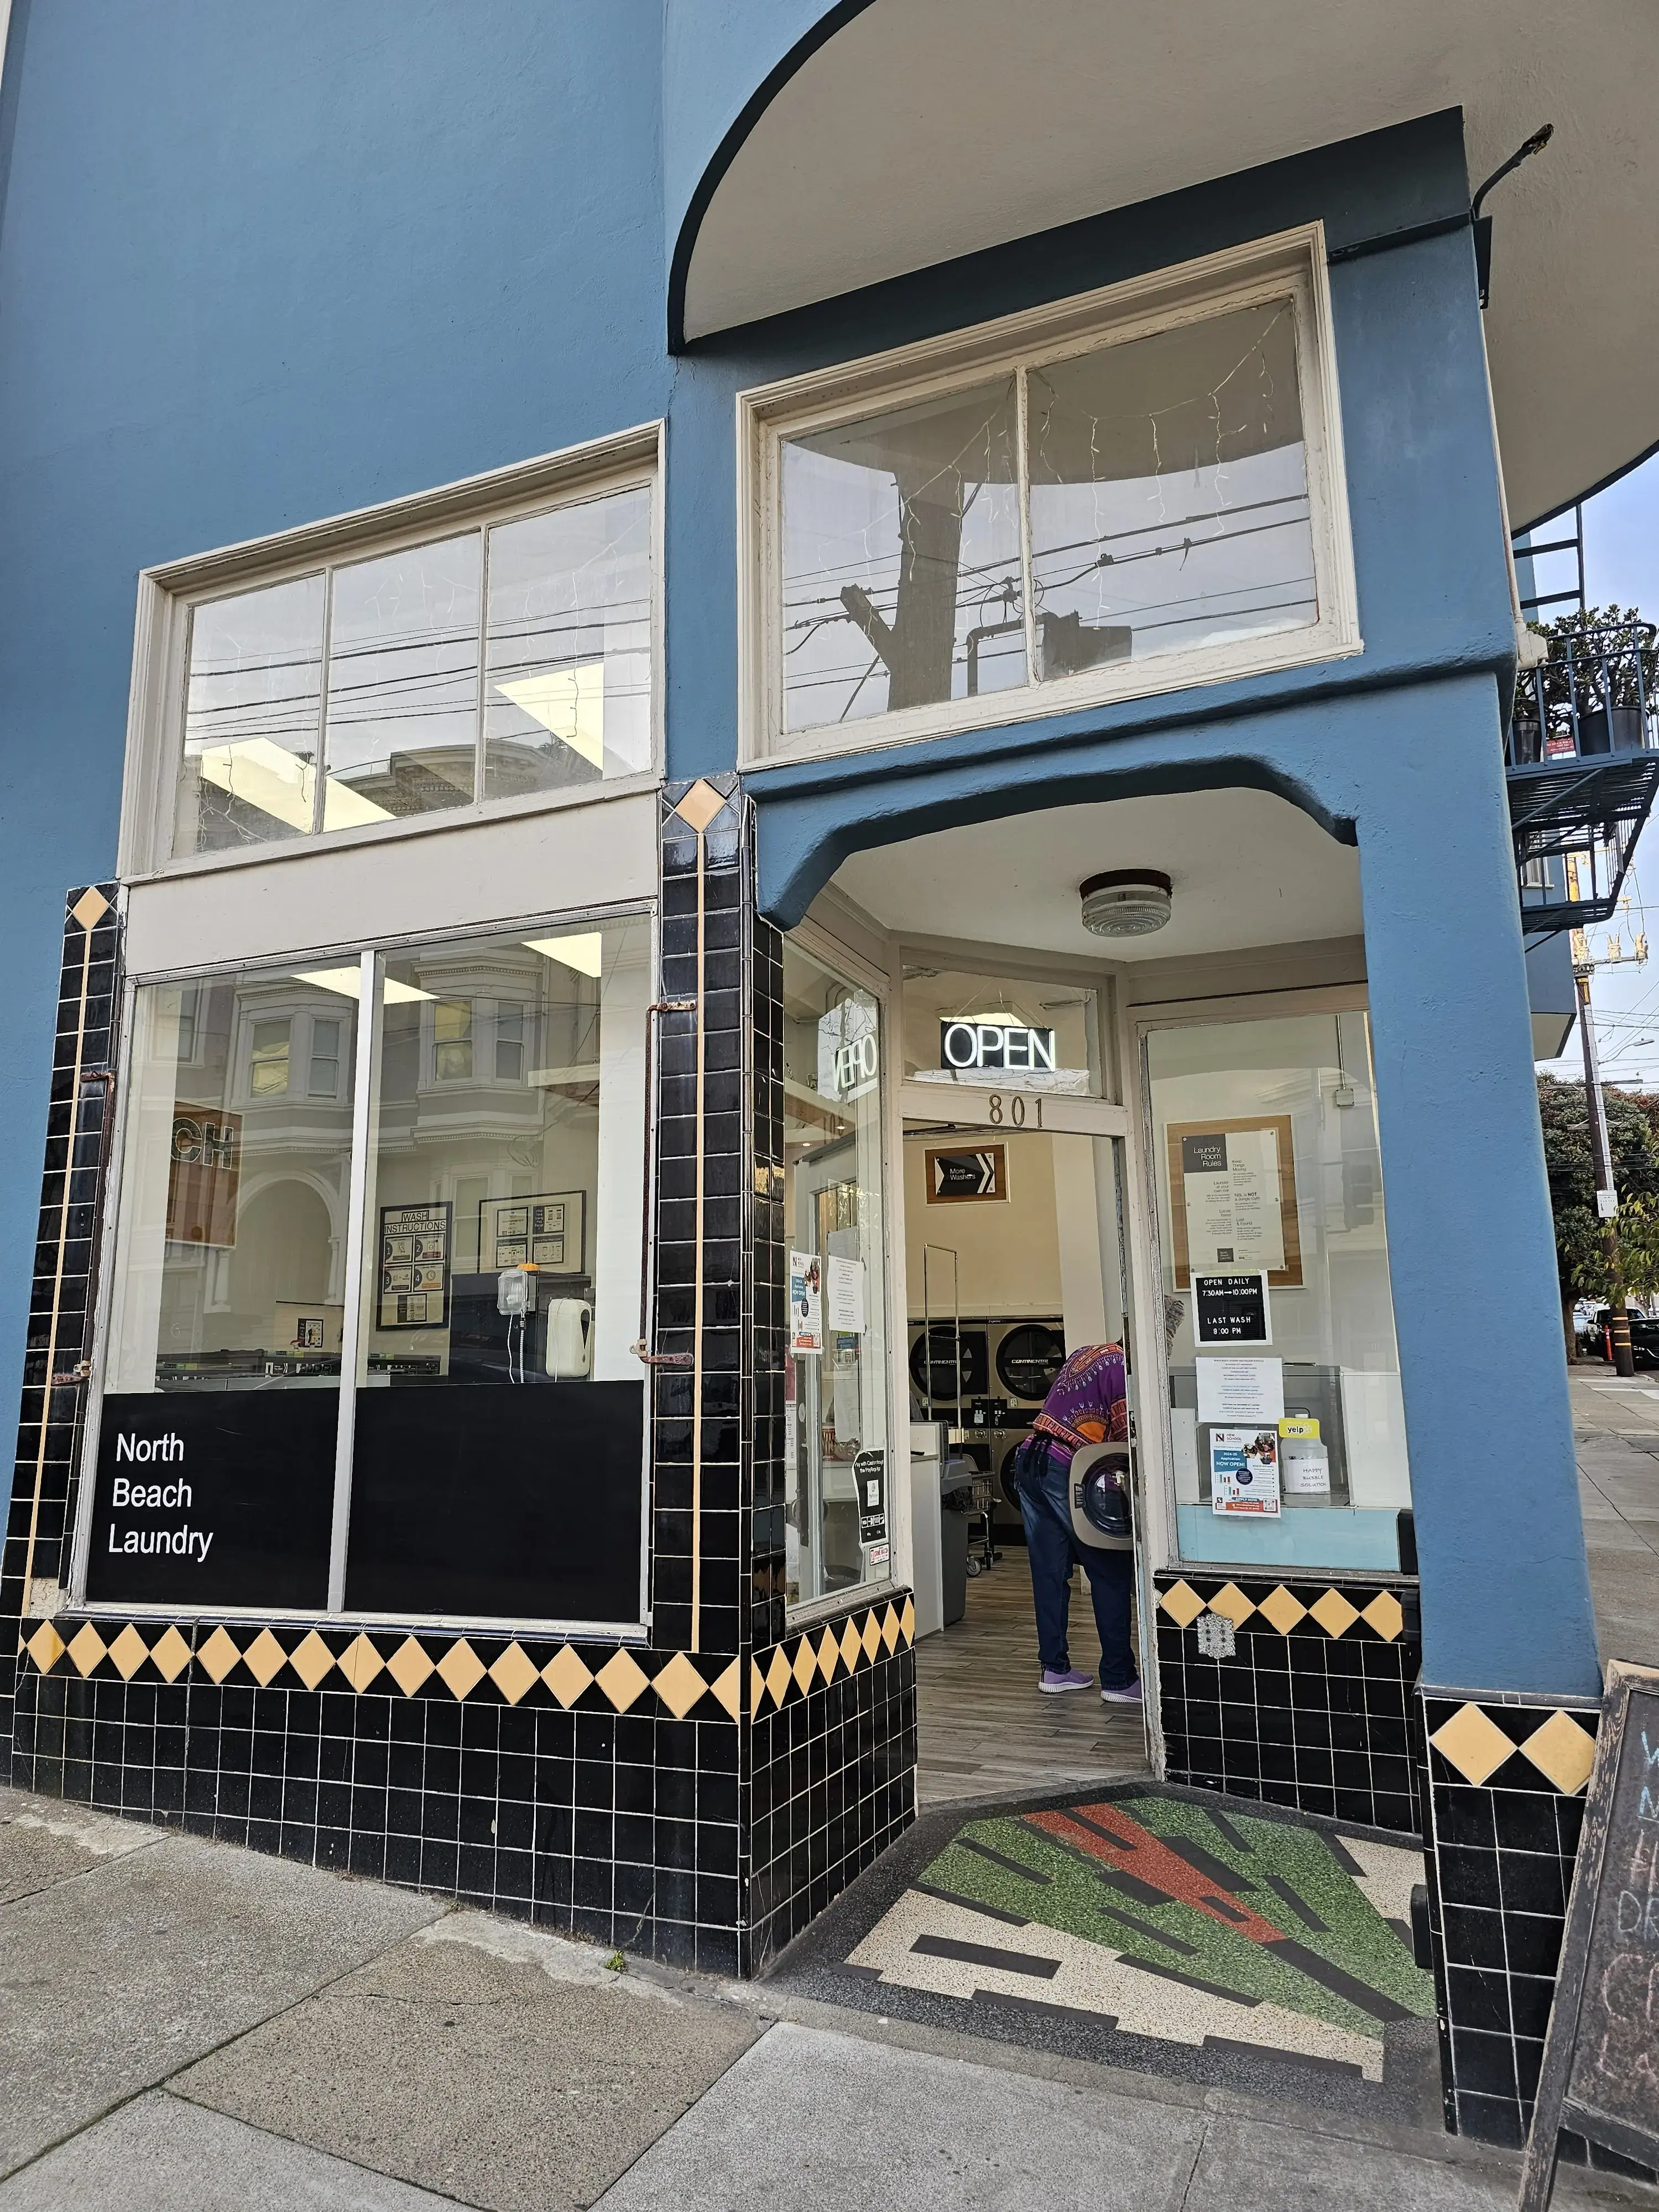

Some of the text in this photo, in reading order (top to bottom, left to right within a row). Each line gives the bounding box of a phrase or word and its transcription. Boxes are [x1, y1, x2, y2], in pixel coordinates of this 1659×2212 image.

[945, 1023, 1056, 1072] OPEN
[989, 1094, 1043, 1129] 801
[384, 1221, 446, 1234] INSTRUCTIONS
[403, 1212, 428, 1222] WASH
[116, 1433, 184, 1462] North
[112, 1478, 192, 1507] Beach
[108, 1524, 213, 1563] Laundry
